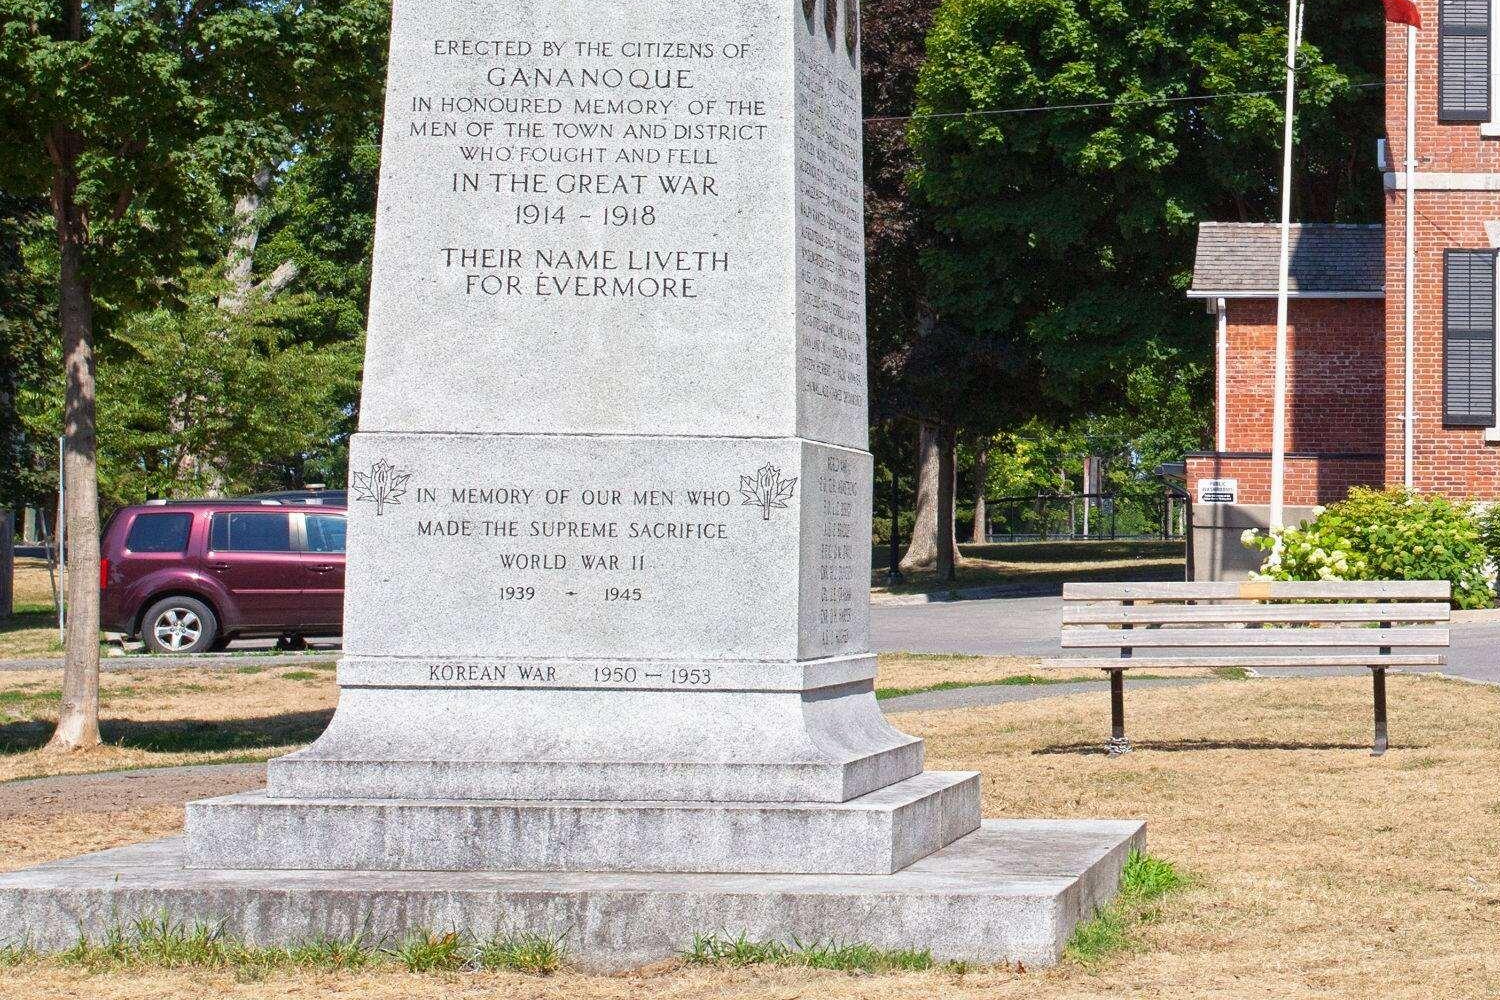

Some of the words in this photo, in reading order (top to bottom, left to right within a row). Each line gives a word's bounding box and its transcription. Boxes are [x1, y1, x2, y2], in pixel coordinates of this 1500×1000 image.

[434, 39, 532, 57] ERECTED
[543, 40, 566, 57] BY
[575, 41, 613, 57] THE
[621, 42, 713, 59] CITIZENS
[724, 43, 751, 59] OF
[487, 67, 694, 90] GANANOQUE
[412, 97, 431, 113] IN
[441, 97, 562, 114] HONOURED
[574, 98, 671, 115] MEMORY
[689, 99, 717, 116] OF
[726, 100, 765, 116] THE
[410, 121, 456, 137] MEN
[466, 121, 494, 137] OF
[504, 122, 544, 139] THE
[554, 123, 613, 139] TOWN
[624, 123, 666, 140] AND
[674, 123, 767, 141] DISTRICT
[460, 145, 510, 162] WHO
[520, 146, 606, 163] FOUGHT
[615, 147, 659, 164] AND
[668, 148, 718, 165] FELL
[452, 173, 482, 192] IN
[490, 173, 547, 193] THE
[557, 174, 647, 194] GREAT
[659, 175, 719, 195] WAR
[516, 204, 566, 225] 1914
[603, 205, 656, 226] 1918
[440, 248, 522, 268] THEIR
[536, 249, 618, 270] NAME
[629, 250, 729, 271] LIVETH
[466, 275, 522, 295] FOR
[536, 277, 697, 298] EVERMORE
[416, 488, 437, 505] IN
[452, 488, 534, 506] MEMORY
[545, 488, 570, 505] OF
[582, 489, 622, 506] OUR
[633, 489, 675, 506] MEN
[686, 489, 731, 507] WHO
[417, 521, 471, 536] MADE
[482, 521, 519, 537] THE
[530, 521, 618, 538] SUPREME
[629, 522, 728, 539] SACRIFICE
[500, 554, 567, 570] WORLD
[581, 554, 622, 570] WAR
[631, 555, 645, 571] II
[499, 587, 535, 600] 1939
[604, 588, 642, 601] 1945
[429, 665, 507, 682] KOREAN
[519, 666, 556, 682] WAR
[593, 667, 637, 683] 1950
[671, 668, 711, 684] 1953
